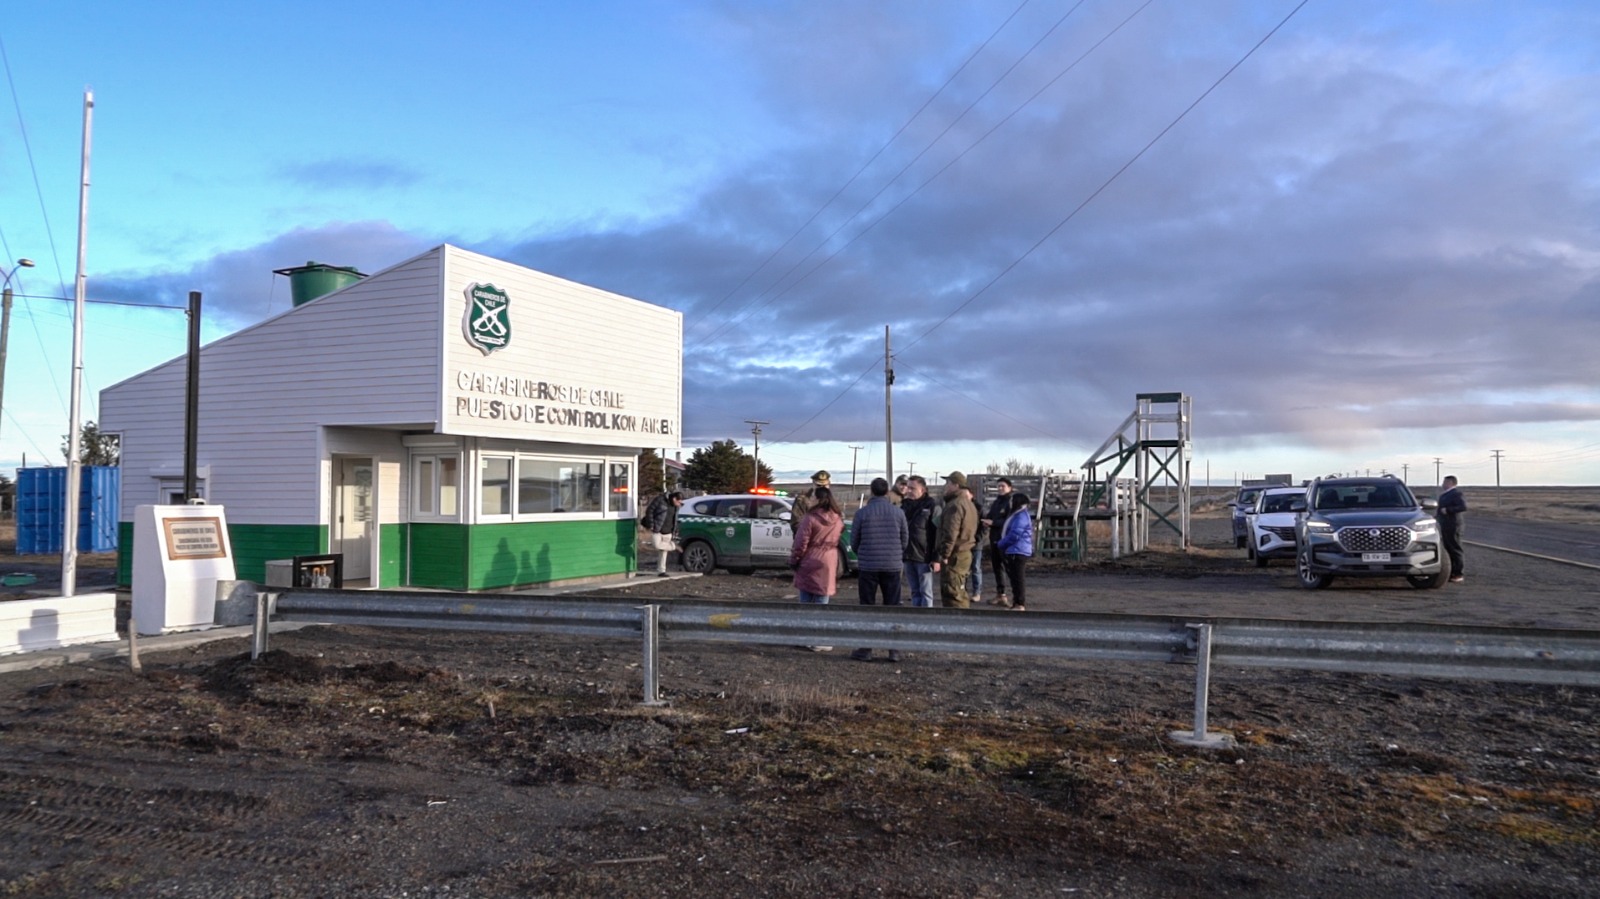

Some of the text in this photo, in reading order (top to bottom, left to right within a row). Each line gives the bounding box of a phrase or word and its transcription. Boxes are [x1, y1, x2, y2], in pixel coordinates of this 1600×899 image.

[484, 299, 496, 308] CHILE
[457, 371, 625, 410] CARABINEROS DE CHILE
[456, 396, 522, 421] PUESTO
[525, 403, 545, 424] DE
[547, 407, 611, 430] CONTROL
[611, 413, 636, 432] KON
